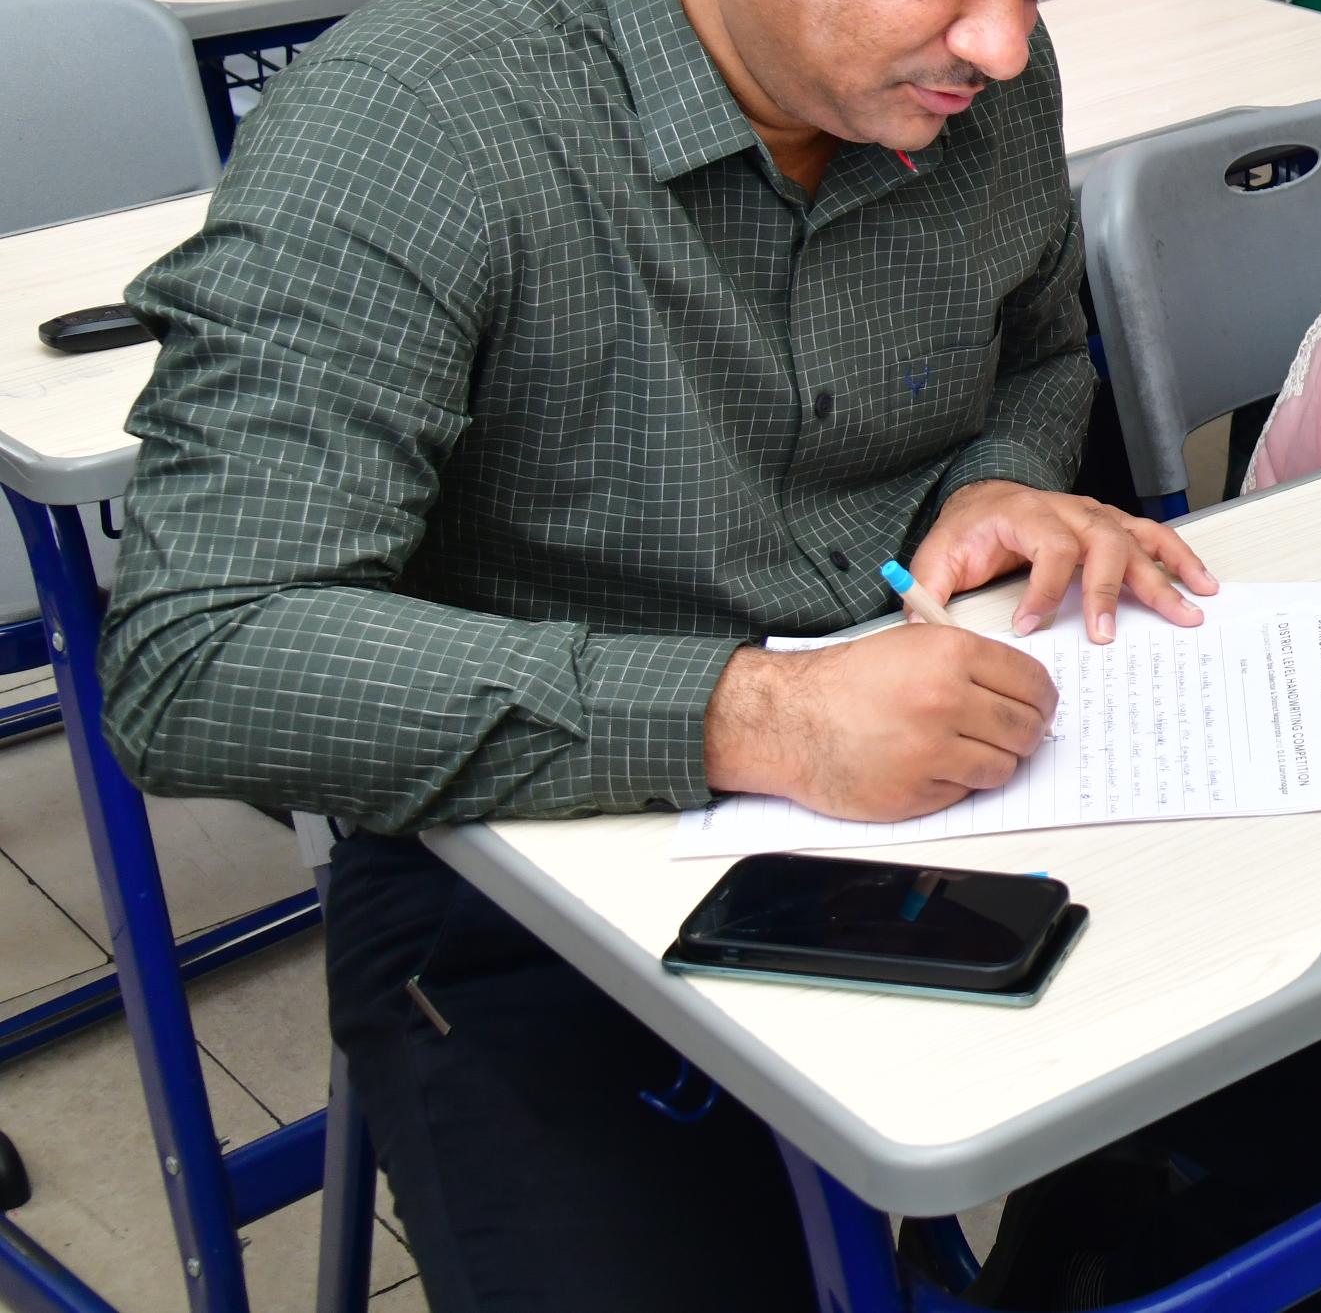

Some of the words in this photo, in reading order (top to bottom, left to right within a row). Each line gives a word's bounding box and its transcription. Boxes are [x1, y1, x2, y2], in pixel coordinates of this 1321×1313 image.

[1277, 622, 1292, 654] DISTRICT
[1282, 657, 1296, 677] LEVEL
[1285, 678, 1302, 731] HANDWRITING
[1292, 732, 1310, 787] COMPETITION
